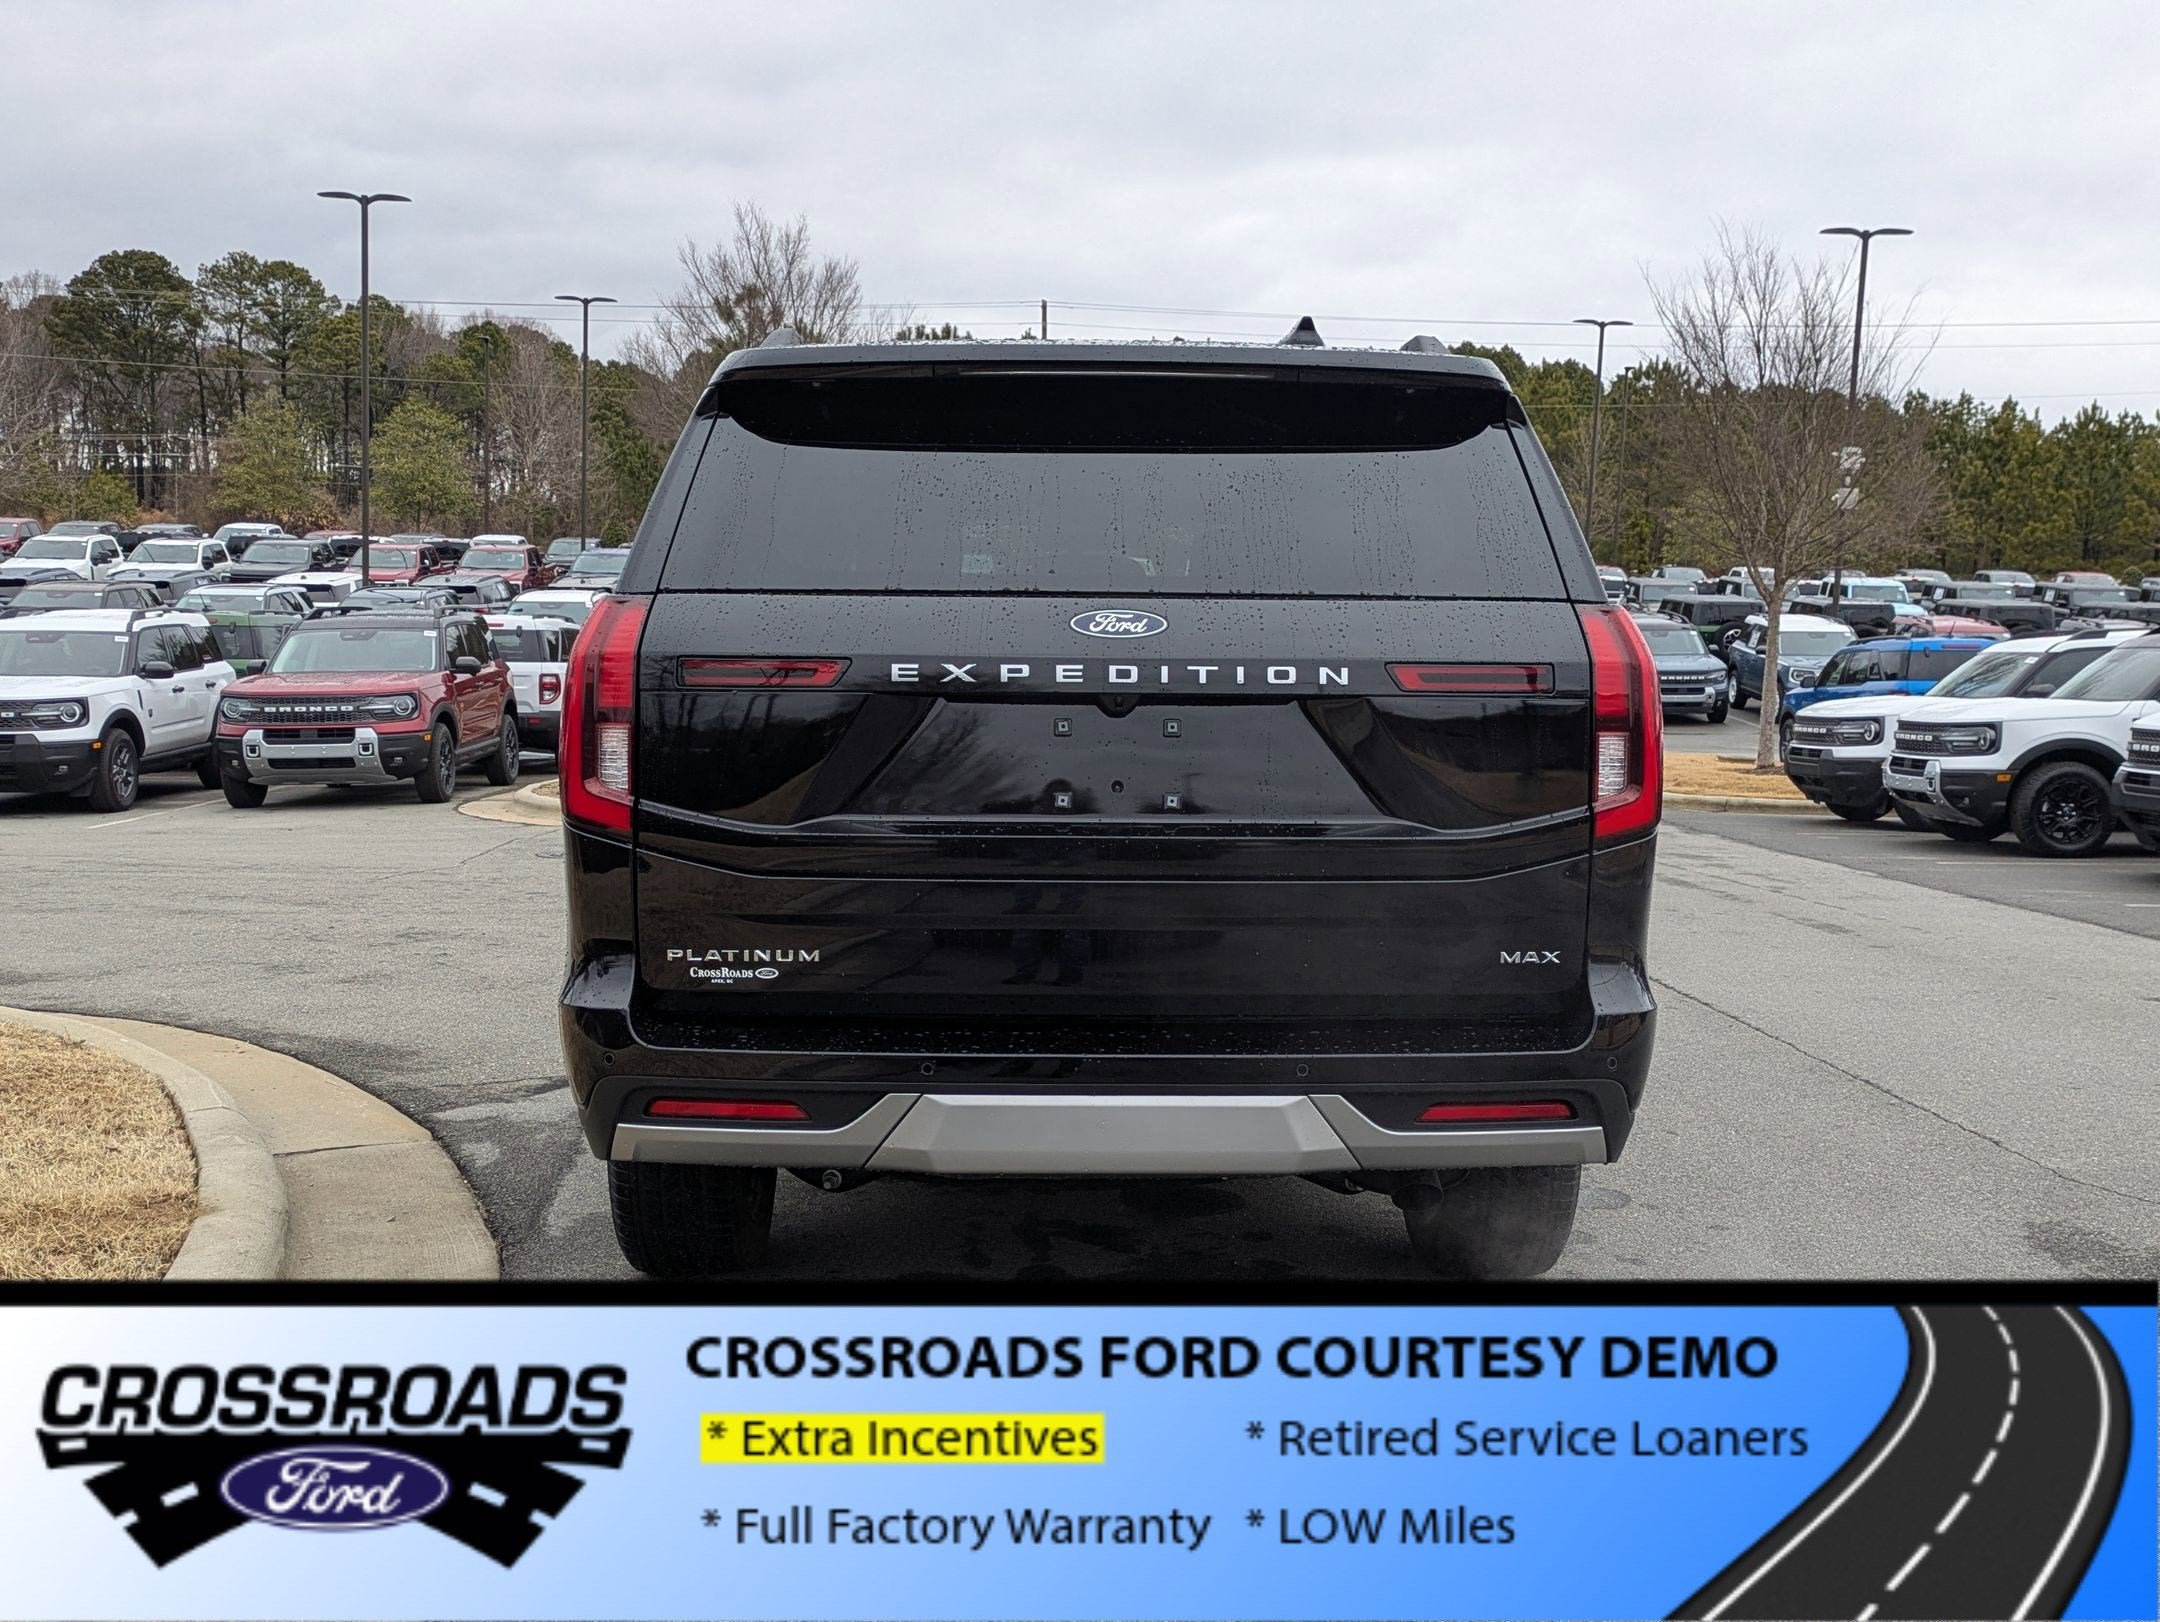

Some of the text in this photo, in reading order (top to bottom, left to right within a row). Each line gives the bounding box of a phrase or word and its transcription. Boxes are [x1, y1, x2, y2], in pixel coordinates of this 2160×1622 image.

[1089, 612, 1149, 633] Ford
[890, 663, 1350, 686] EXPEDITION
[1895, 733, 1933, 741] BRONCO
[666, 949, 820, 962] PLATINUM
[1500, 951, 1561, 964] MAX
